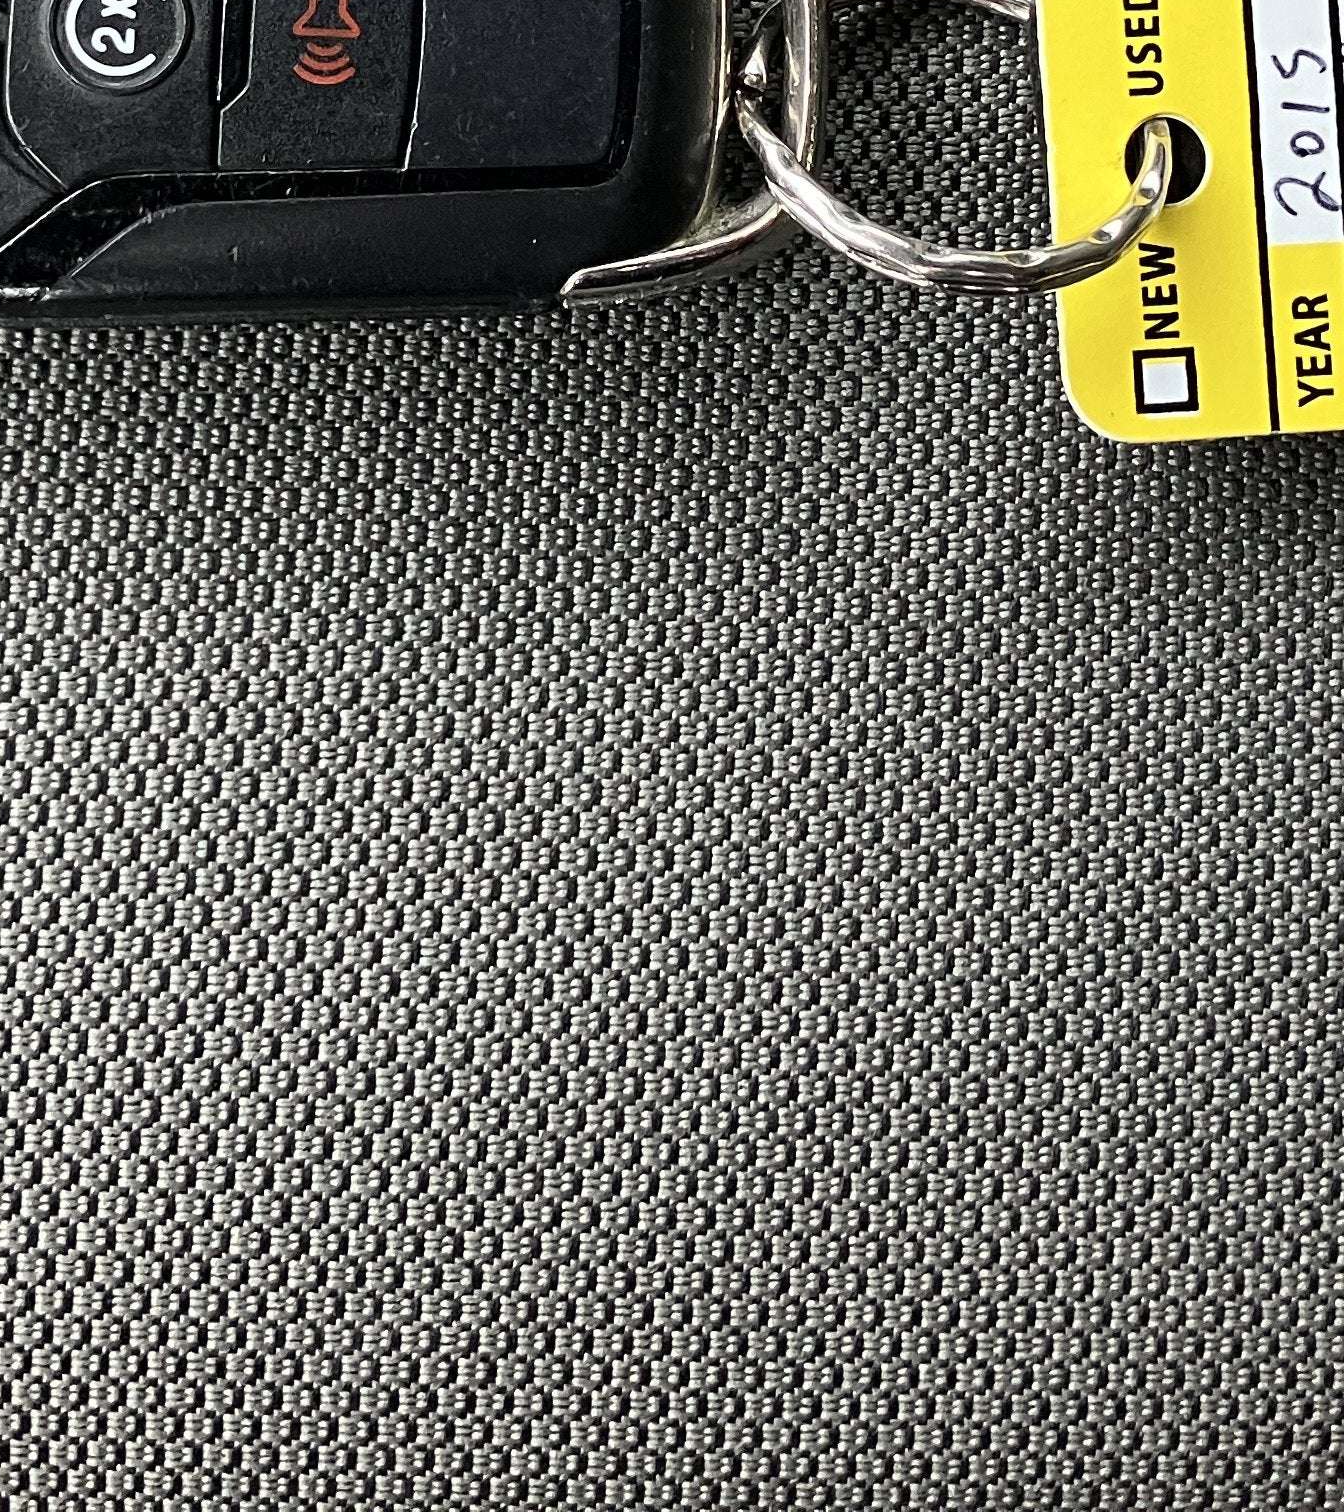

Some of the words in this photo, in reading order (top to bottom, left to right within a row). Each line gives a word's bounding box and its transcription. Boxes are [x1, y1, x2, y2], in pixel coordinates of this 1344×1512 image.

[1271, 48, 1342, 216] 2015
[1140, 242, 1180, 340] NEW
[1292, 293, 1333, 407] YEAR
